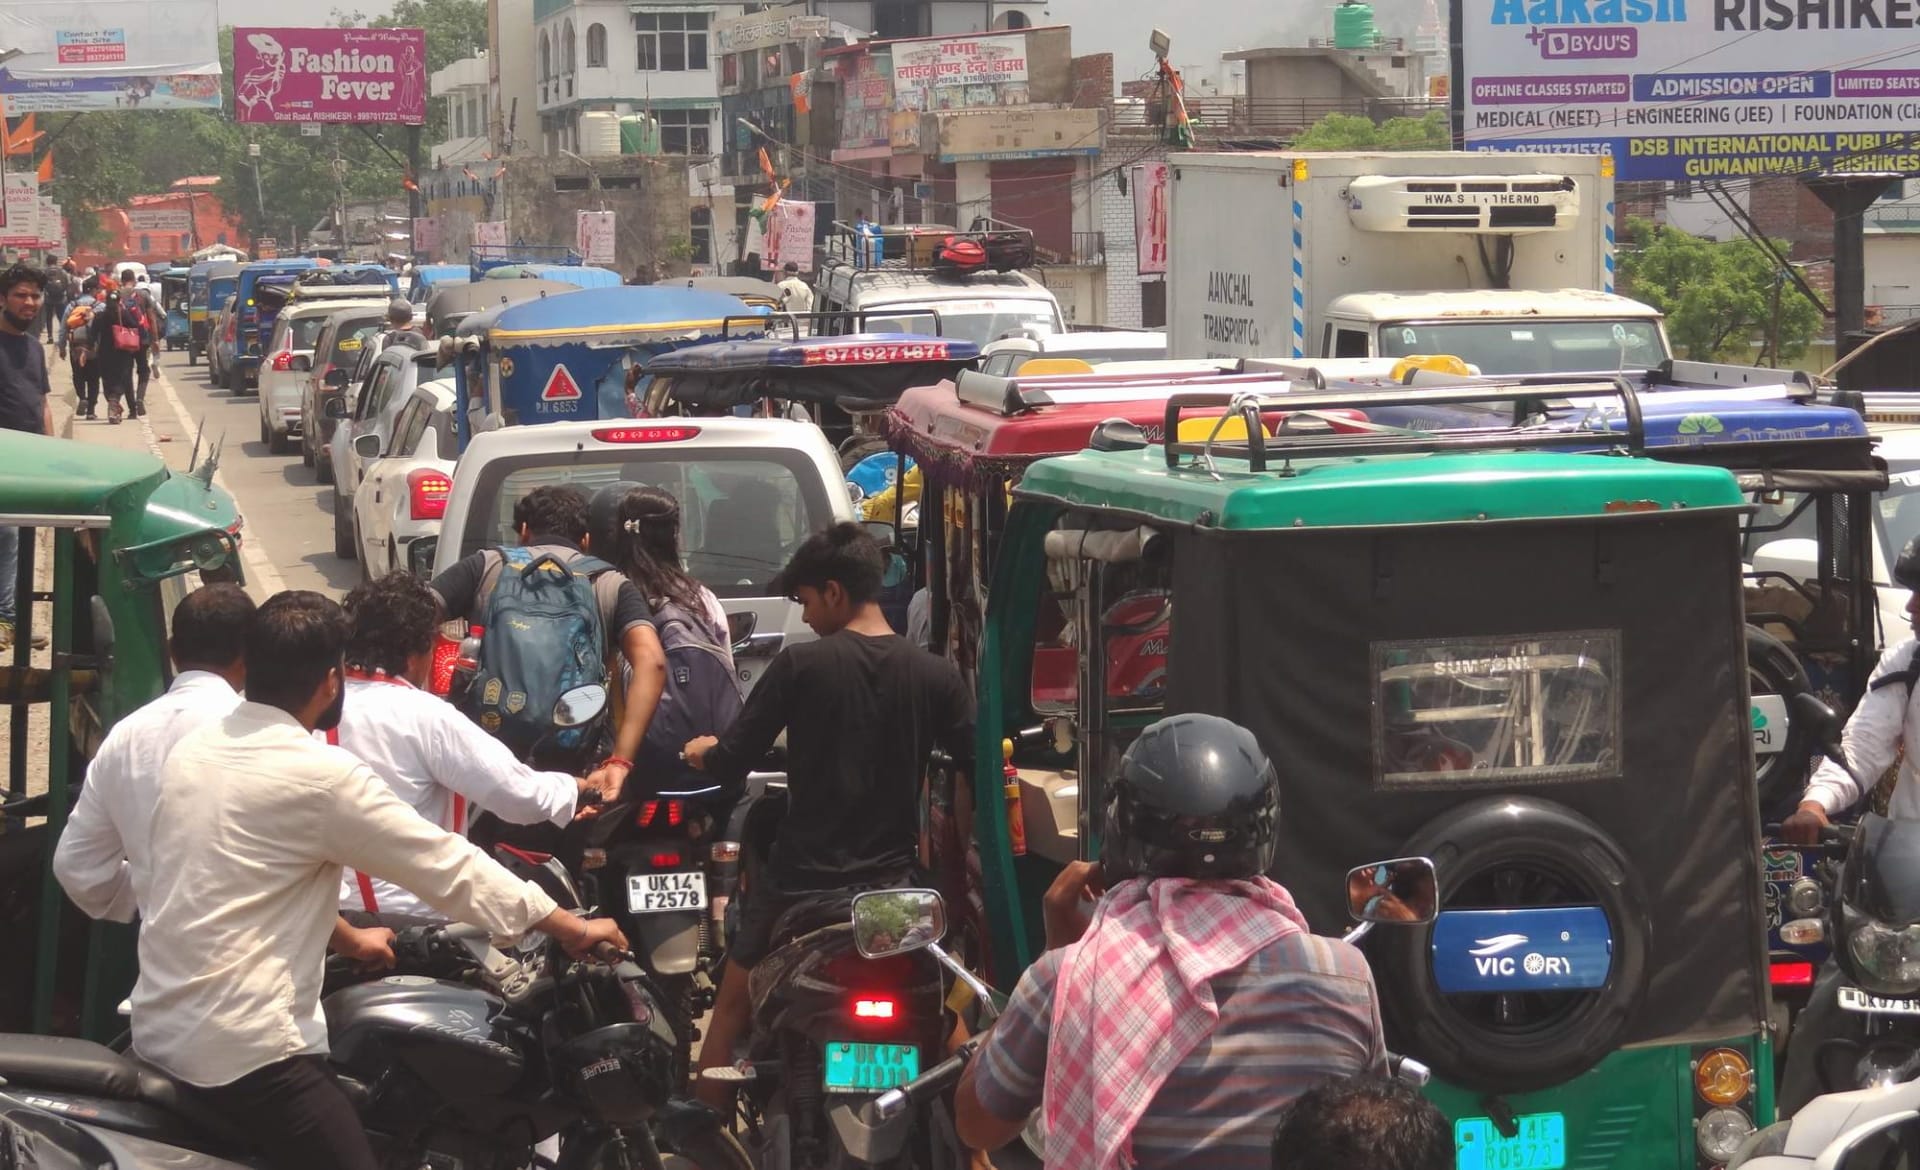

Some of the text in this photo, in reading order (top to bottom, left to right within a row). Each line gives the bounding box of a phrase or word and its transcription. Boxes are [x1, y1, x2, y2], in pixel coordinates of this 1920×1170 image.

[1714, 0, 1920, 31] RISHIKE
[1571, 35, 1631, 51] BYJU'S
[290, 47, 395, 73] Fashion
[321, 74, 395, 101] Fever
[1475, 82, 1626, 98] OFFLINE CLASSES STARTED
[1651, 76, 1814, 97] ADMISSION OPEN
[1838, 76, 1920, 90] LIMITED SEATS
[313, 111, 352, 121] RISHIKESH
[1476, 111, 1545, 129] MEDICAL
[1549, 109, 1601, 129] (NEET)
[1626, 106, 1730, 125] ENGINEERING
[1734, 105, 1774, 125] (JEE)
[1794, 104, 1893, 121] FOUNDATION
[1629, 138, 1669, 157] DSB
[1674, 135, 1831, 155] INTERNATIONAL
[1836, 133, 1905, 152] PUBLIC
[1207, 271, 1254, 307] AANCHAL
[1203, 313, 1249, 344] TRANSPORT
[648, 874, 693, 892] UK14
[644, 890, 700, 909] F2578
